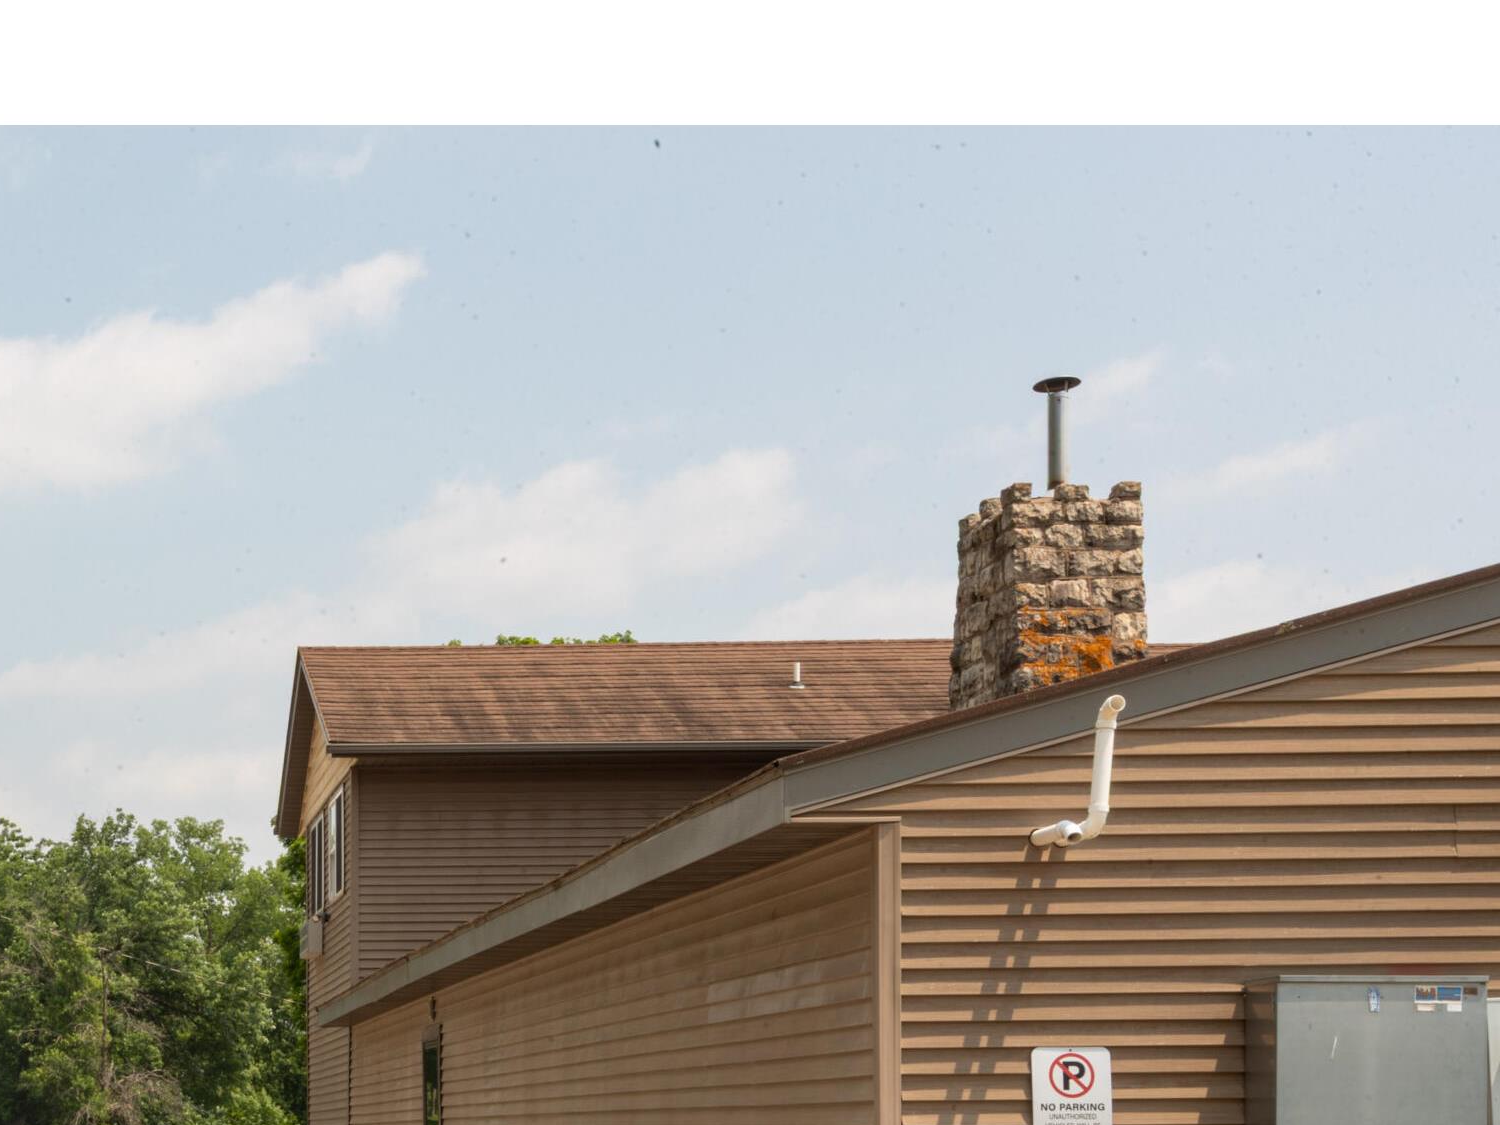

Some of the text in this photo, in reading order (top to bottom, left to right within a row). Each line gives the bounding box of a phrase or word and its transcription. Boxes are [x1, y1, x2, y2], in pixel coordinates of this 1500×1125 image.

[1062, 1061, 1085, 1090] P
[1040, 1103, 1105, 1111] NO PARKING
